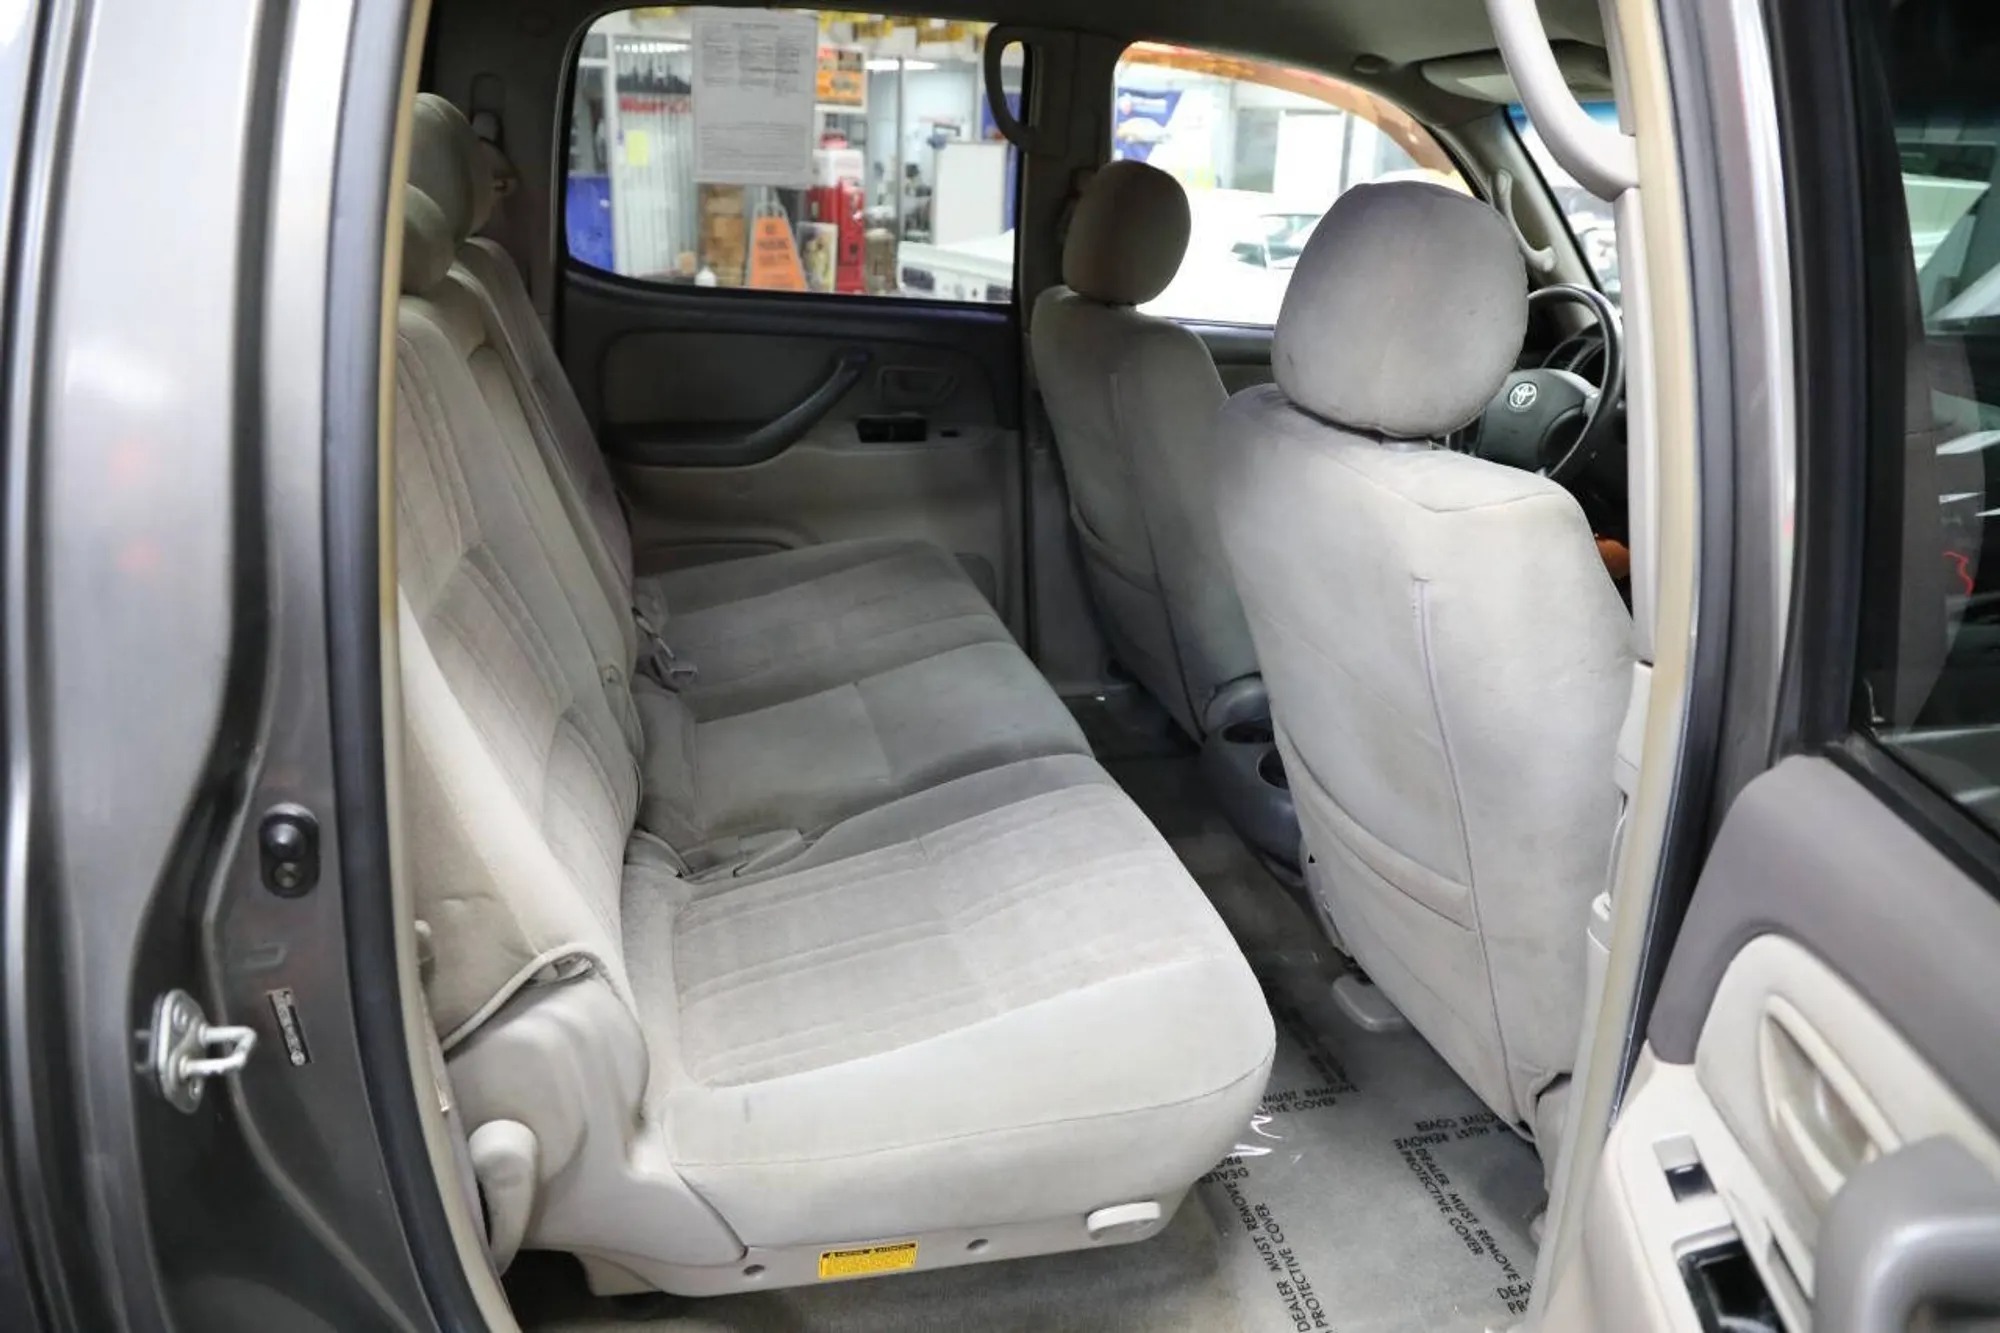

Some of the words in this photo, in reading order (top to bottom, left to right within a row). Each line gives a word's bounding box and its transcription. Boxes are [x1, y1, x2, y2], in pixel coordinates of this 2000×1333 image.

[1224, 1181, 1259, 1231] REMOVE
[1255, 1203, 1285, 1243] COVER
[1400, 1150, 1453, 1213] PROTECTIVE
[1449, 1217, 1484, 1255] COVER
[1415, 1148, 1450, 1186] DEALER
[1448, 1193, 1480, 1224] MUST
[1476, 1228, 1520, 1281] REMOVE
[1253, 1235, 1282, 1272] MUST
[1276, 1279, 1311, 1333] DEALER
[1279, 1247, 1328, 1328] PROTECTIVE
